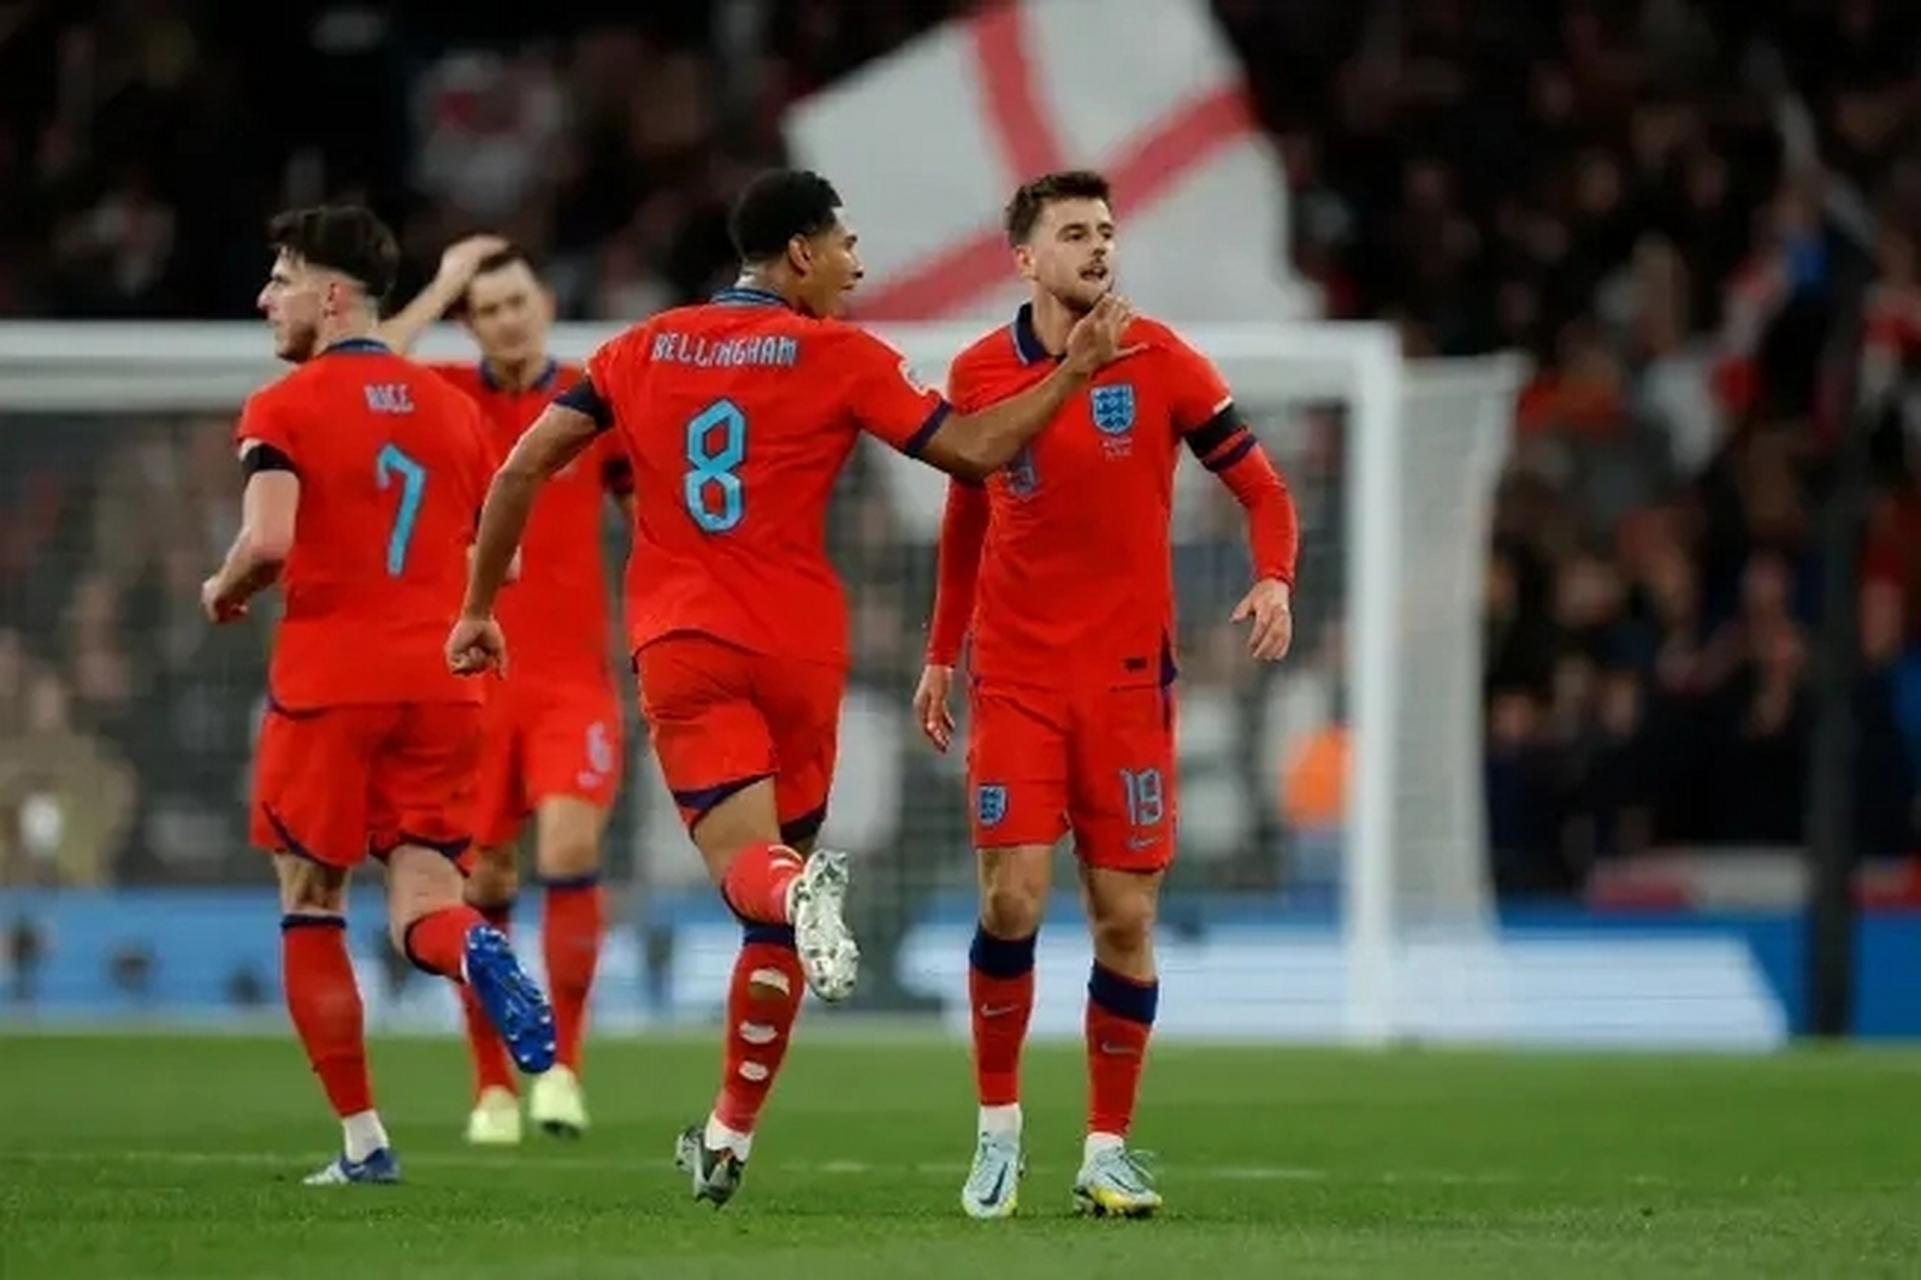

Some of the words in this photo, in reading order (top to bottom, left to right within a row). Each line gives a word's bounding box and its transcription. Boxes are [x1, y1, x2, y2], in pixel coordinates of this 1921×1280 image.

[650, 332, 798, 367] BELLINGHAM
[376, 443, 426, 577] 7
[685, 397, 746, 533] 8
[1120, 767, 1163, 827] 19
